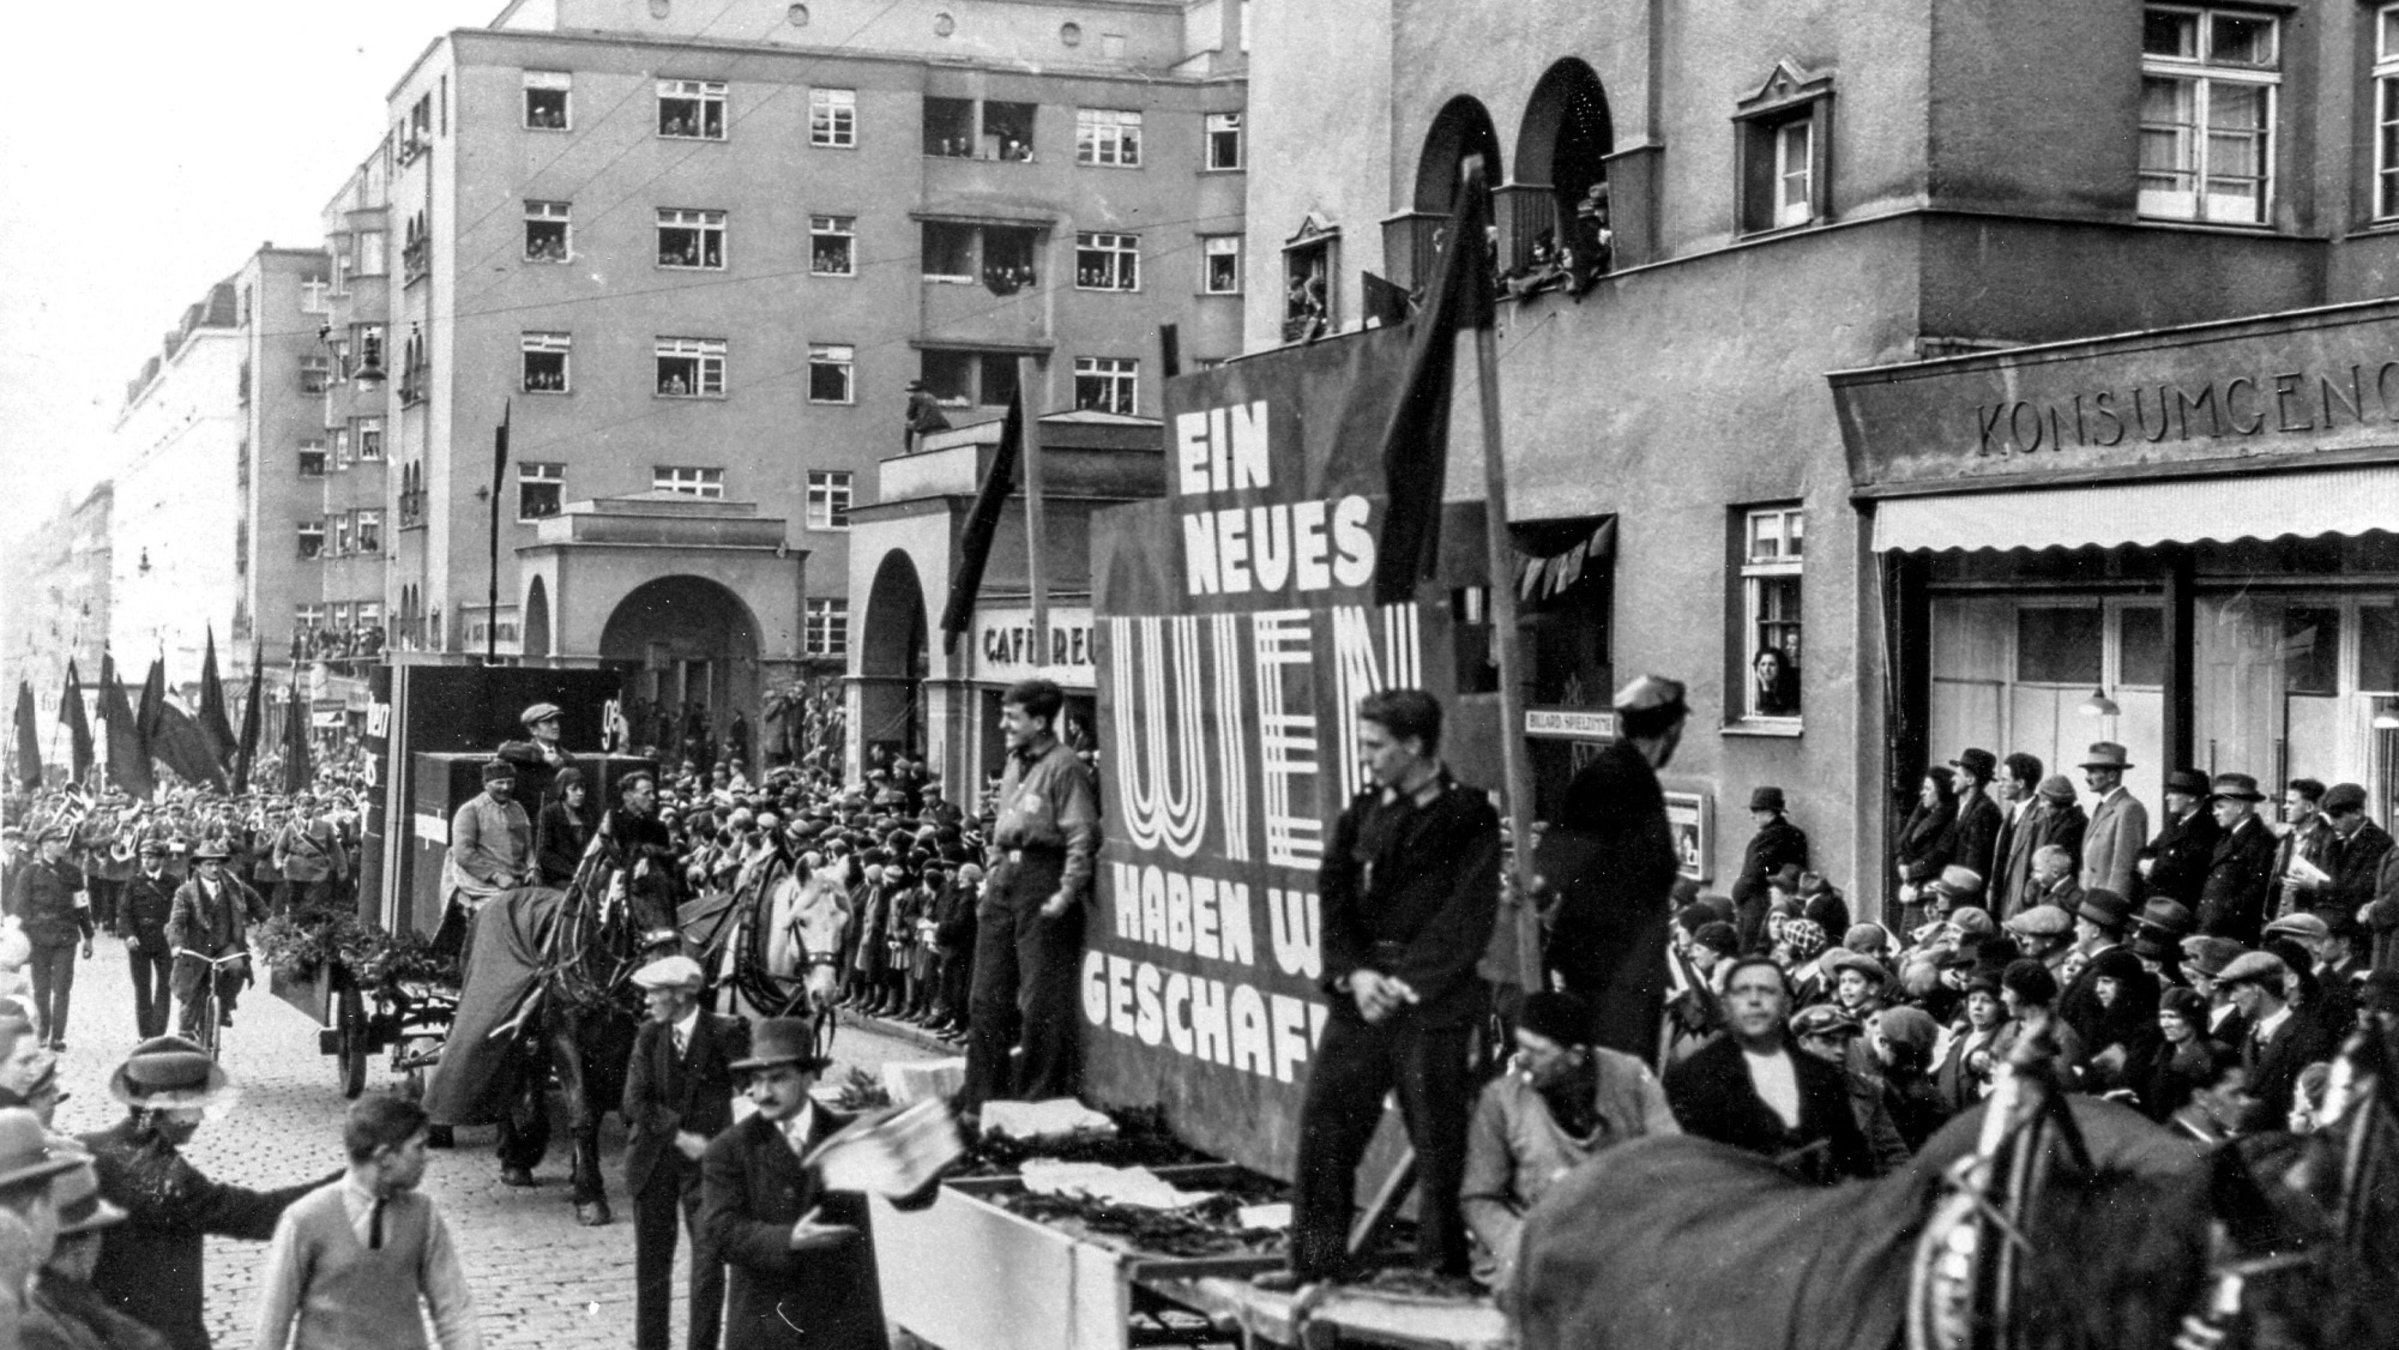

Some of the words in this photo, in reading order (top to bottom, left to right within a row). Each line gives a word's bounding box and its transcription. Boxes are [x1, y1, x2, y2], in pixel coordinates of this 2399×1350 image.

[1176, 400, 1270, 495] EIN
[1183, 494, 1375, 596] NEUES
[1111, 601, 1421, 869] WIEN
[1113, 861, 1254, 966] HABEN
[1081, 950, 1329, 1084] GESCHAF
